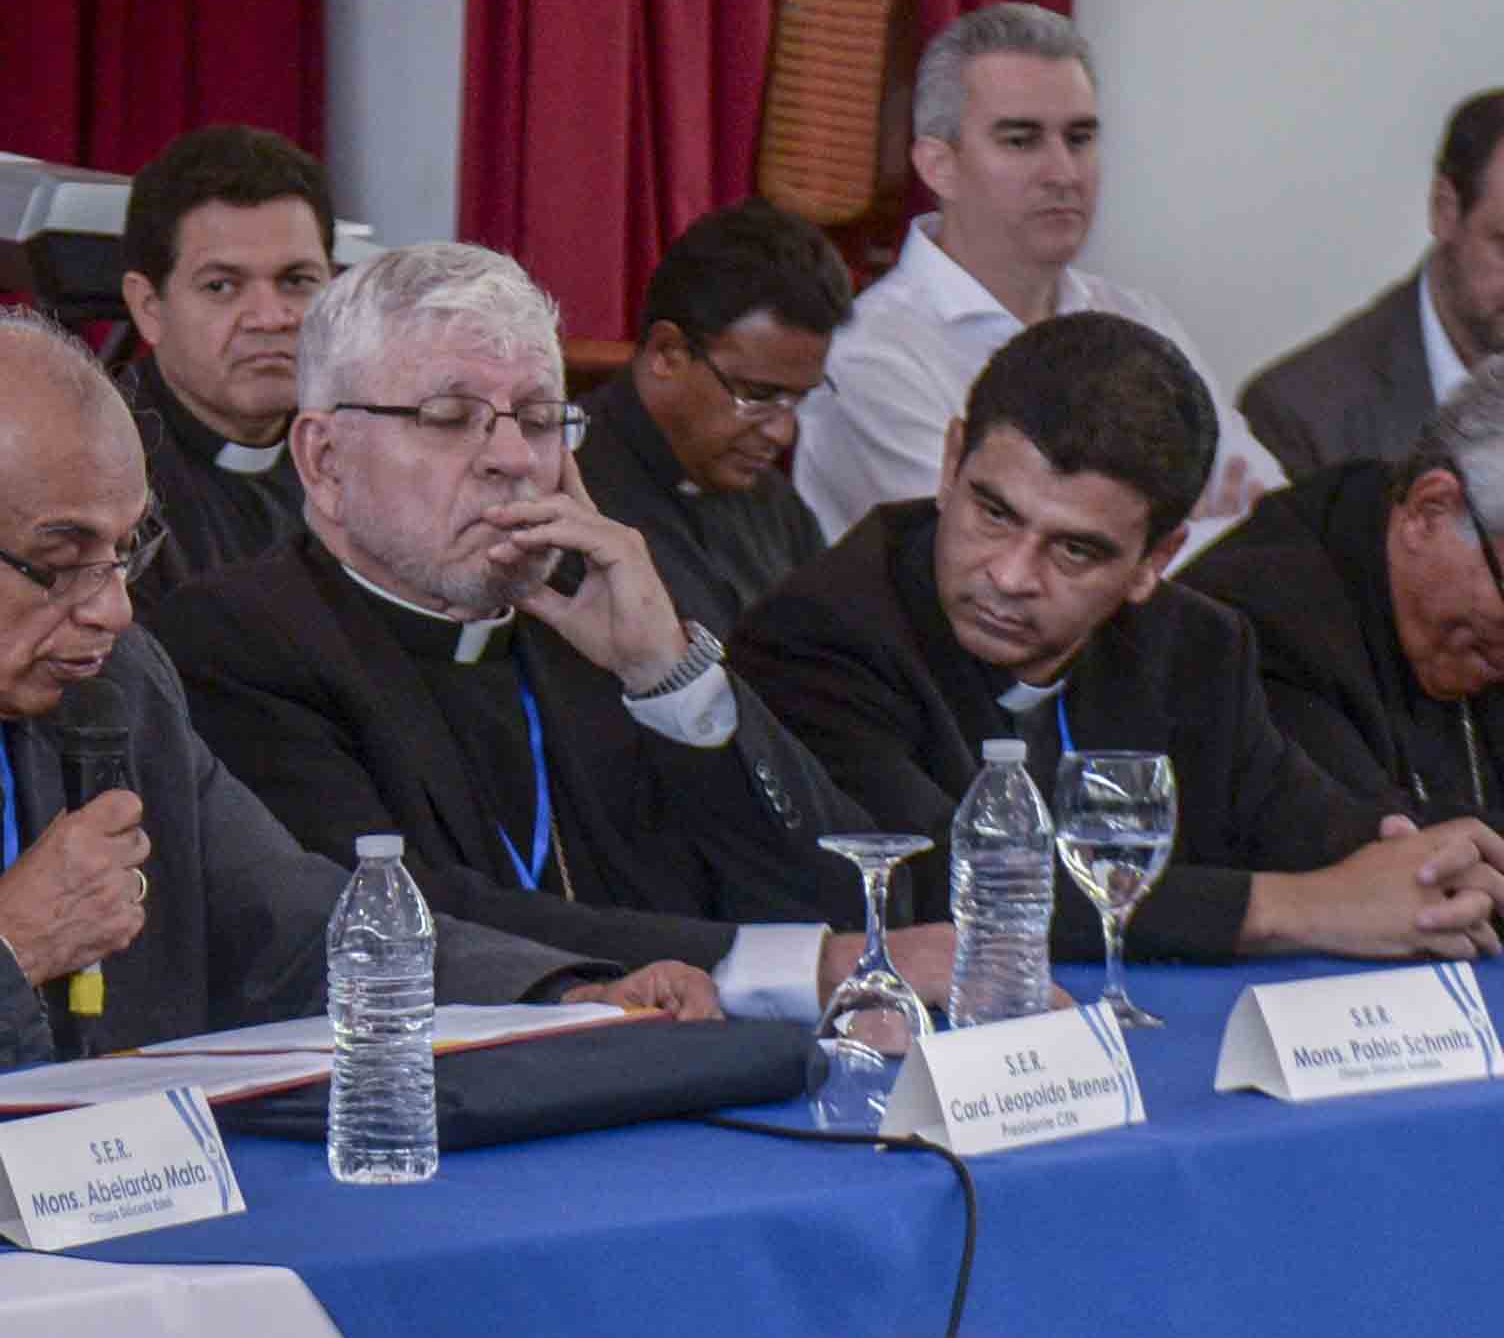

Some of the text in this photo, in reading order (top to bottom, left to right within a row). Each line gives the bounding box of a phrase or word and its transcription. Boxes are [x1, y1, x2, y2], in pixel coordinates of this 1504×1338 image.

[1350, 1035, 1401, 1062] Pablo
[1403, 1027, 1474, 1056] Schmitz
[996, 1081, 1066, 1117] Leopoldo
[1068, 1071, 1118, 1098] Brenes
[89, 1137, 133, 1166] S.E.R.
[31, 1191, 84, 1219] Mons.
[88, 1169, 162, 1206] Abelardo
